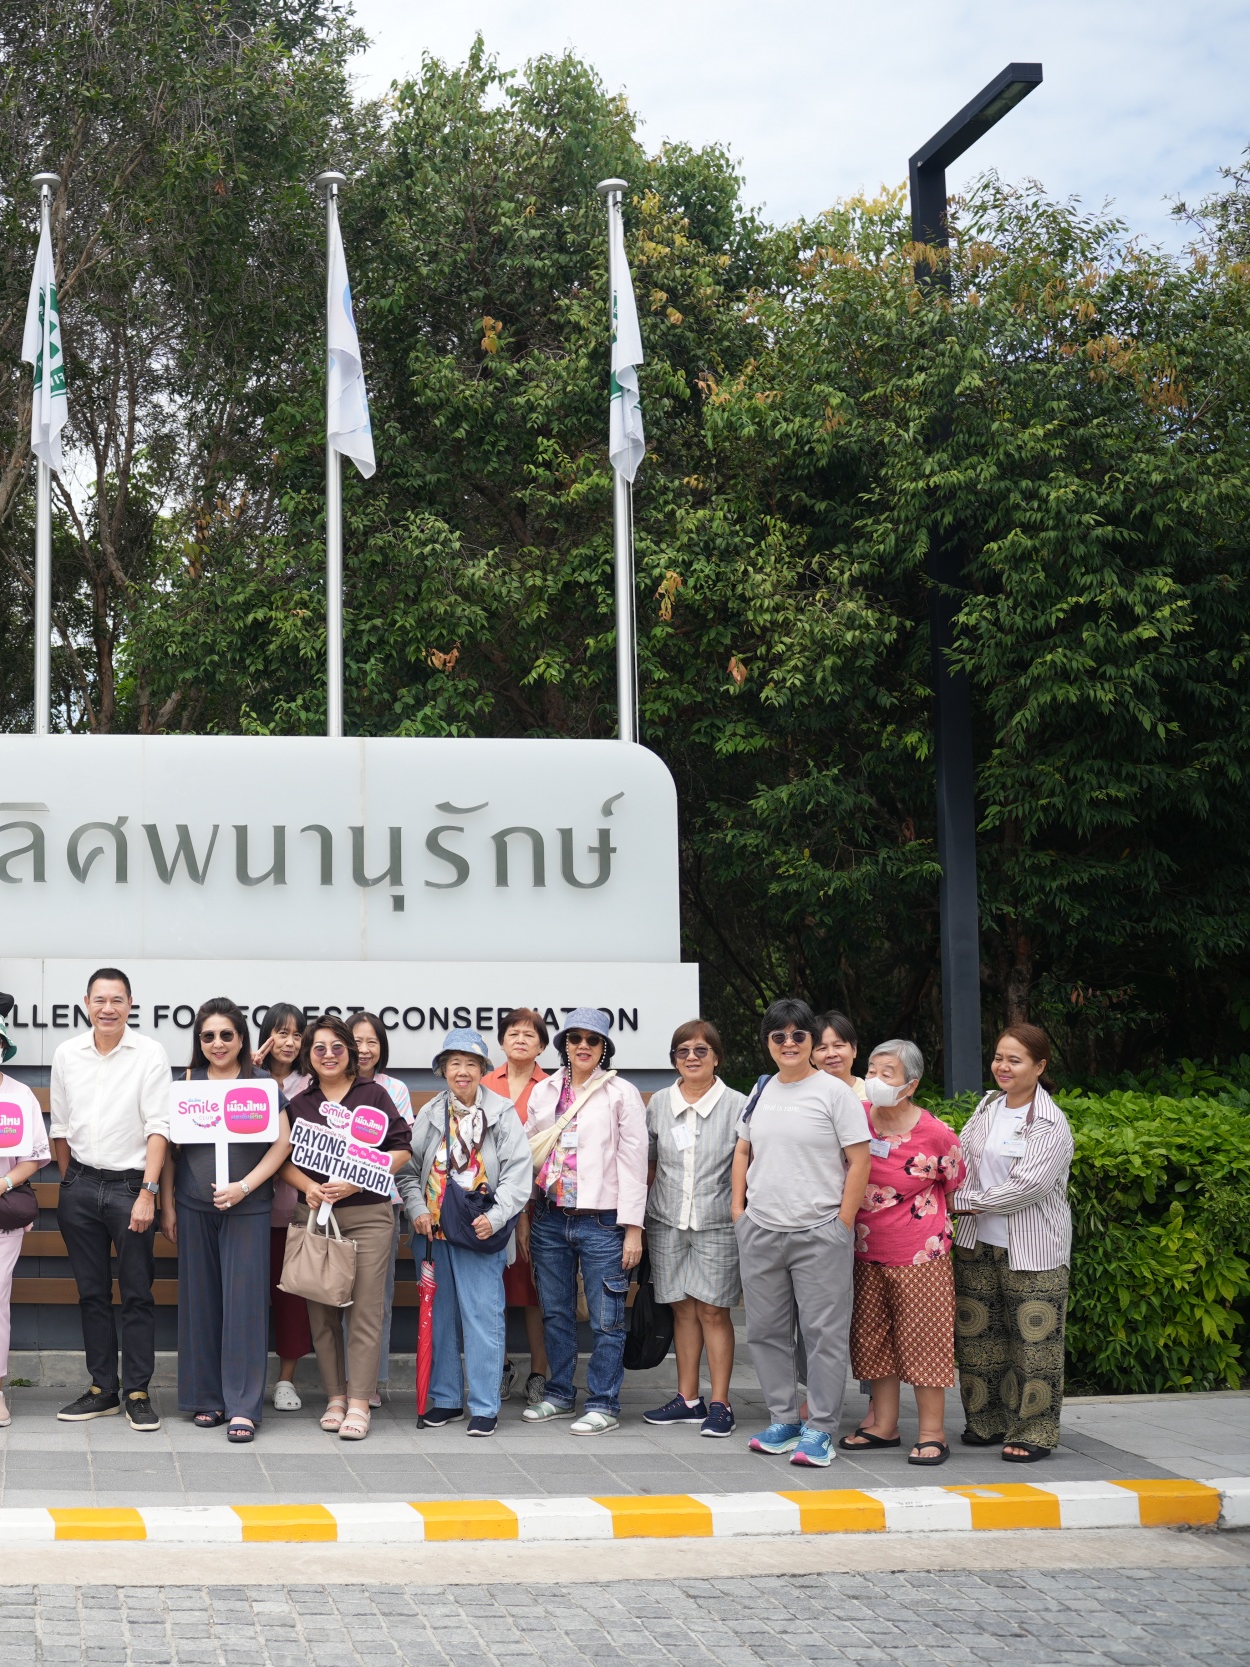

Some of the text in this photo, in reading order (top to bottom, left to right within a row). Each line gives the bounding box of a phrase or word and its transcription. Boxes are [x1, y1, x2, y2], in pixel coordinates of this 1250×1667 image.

[154, 1005, 196, 1029] FO
[178, 1100, 219, 1114] Smile
[227, 1100, 266, 1112] เมืองไทย
[322, 1104, 350, 1119] Smile
[292, 1125, 346, 1157] RAYONG
[294, 1146, 391, 1193] CHANTHABURI
